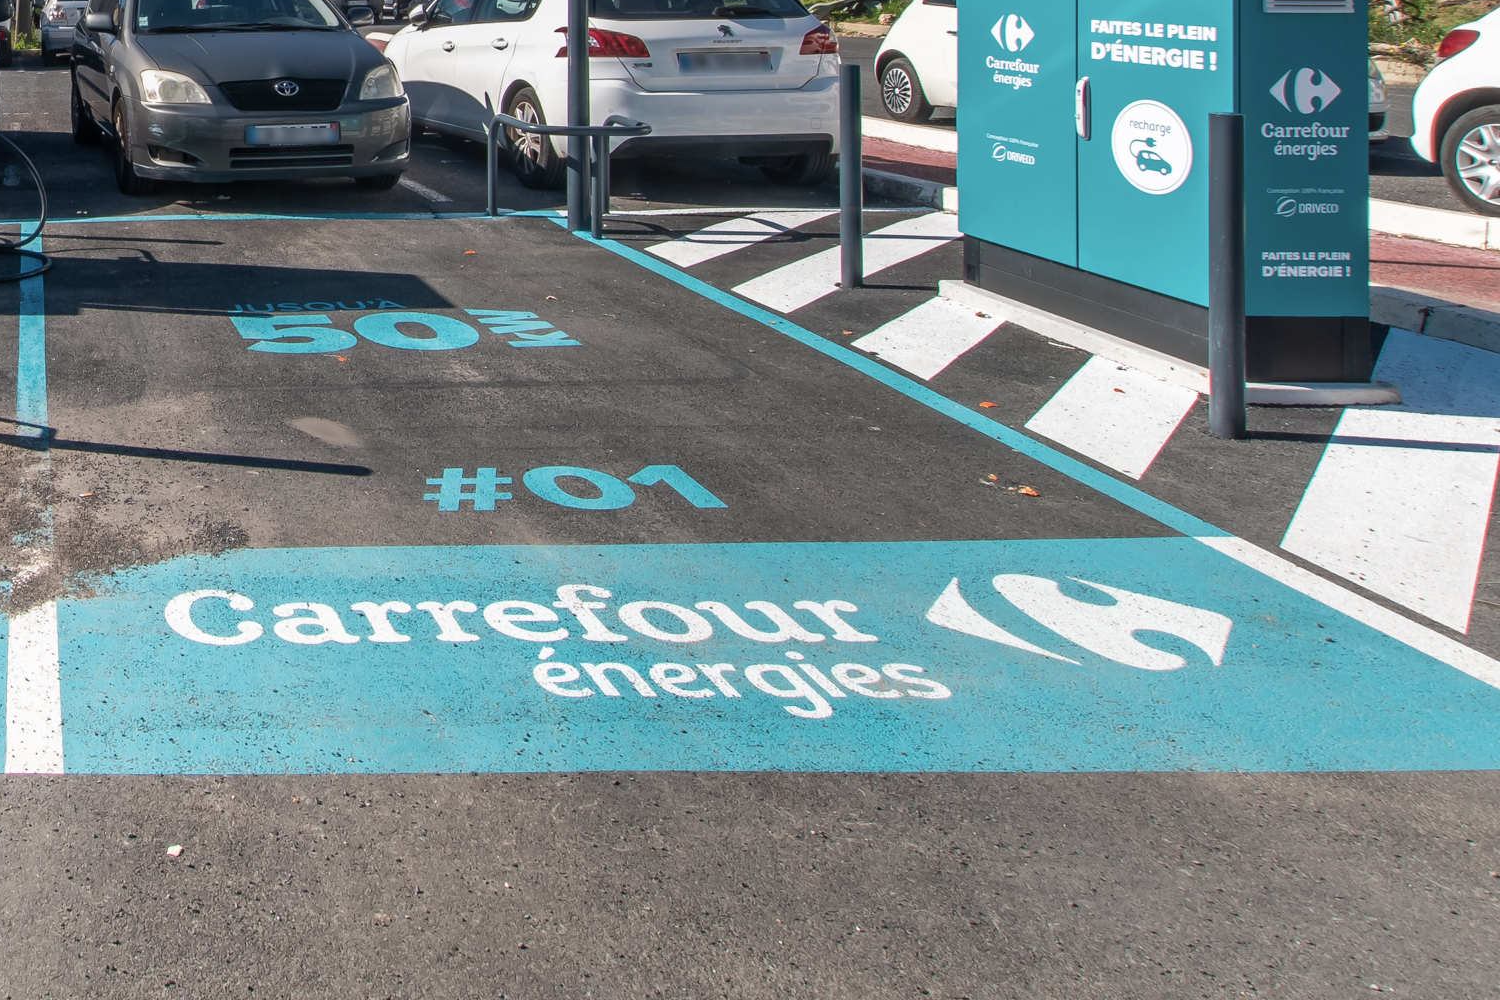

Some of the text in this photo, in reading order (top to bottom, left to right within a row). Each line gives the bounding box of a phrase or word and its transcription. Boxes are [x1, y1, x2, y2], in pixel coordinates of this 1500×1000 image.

[1090, 19, 1217, 41] FAITES LE PLEIN
[985, 55, 1040, 74] Carrefour
[1090, 39, 1218, 71] D'ÉNERGIE !
[992, 70, 1032, 90] énergies
[1129, 119, 1172, 136] recharge
[1260, 121, 1351, 138] Carrefour
[1006, 150, 1036, 165] DRIVECO
[1273, 140, 1339, 161] énergies
[1266, 187, 1300, 195] Conception
[1317, 187, 1345, 195] française
[1298, 203, 1340, 214] DRIVECO
[1261, 251, 1351, 261] FAITES LE PLEIN
[1261, 263, 1344, 278] D'ÉNERGIE
[229, 308, 584, 354] 50 kW
[422, 464, 729, 511] #01
[163, 583, 880, 646] Carrefour
[533, 646, 952, 719] énergies
